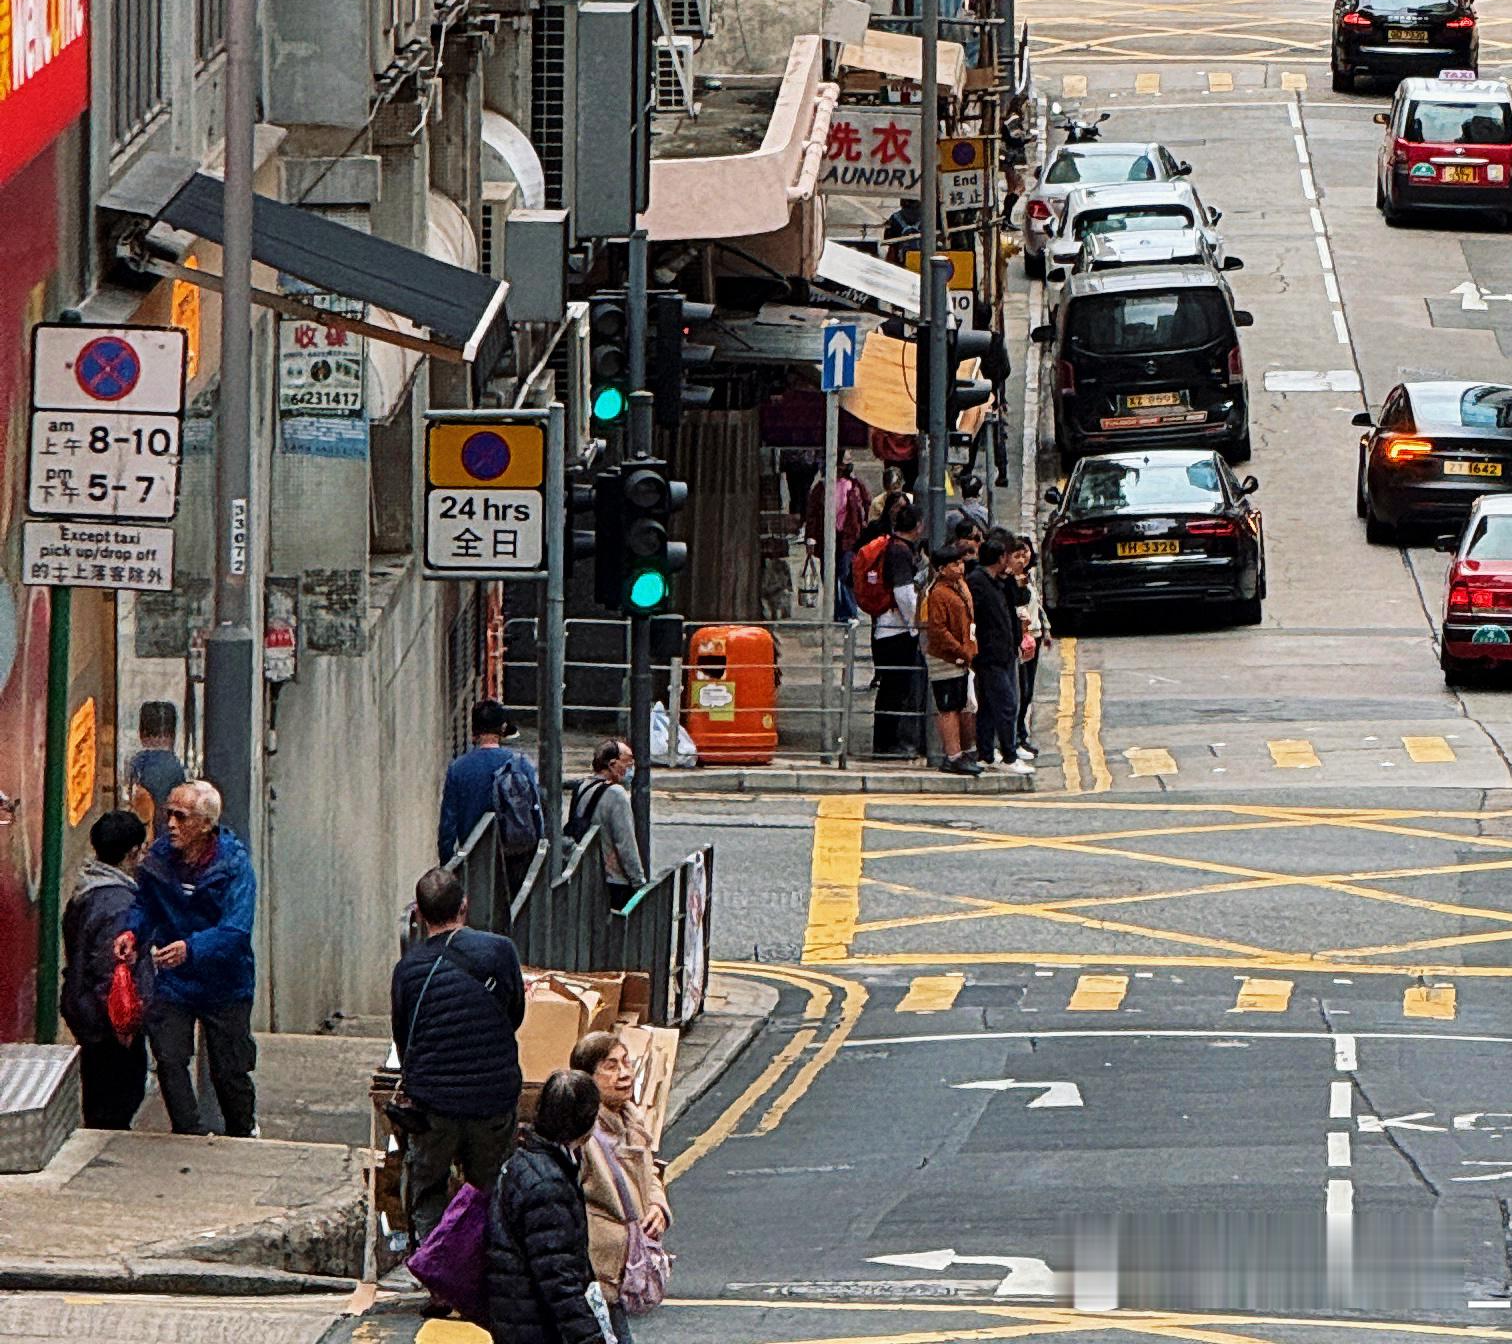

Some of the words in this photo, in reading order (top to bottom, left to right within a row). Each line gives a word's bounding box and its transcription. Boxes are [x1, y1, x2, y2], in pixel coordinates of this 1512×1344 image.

[1444, 71, 1474, 79] TAXI
[826, 121, 912, 165] 洗衣
[820, 166, 922, 190] AUNDRY
[953, 174, 978, 186] End
[48, 421, 75, 432] am
[39, 437, 83, 456] 上午
[88, 426, 171, 457] 8-10
[46, 468, 73, 482] pm
[1469, 463, 1498, 475] 1642
[37, 482, 81, 504] 下午
[440, 496, 476, 519] 24
[483, 498, 531, 521] hrs
[60, 527, 111, 543] Except
[114, 531, 141, 544] taxi
[451, 527, 518, 558] 全日
[40, 544, 71, 558] pick
[76, 547, 132, 562] up/drop
[136, 549, 157, 561] off
[31, 562, 164, 585] 的士上落客除外
